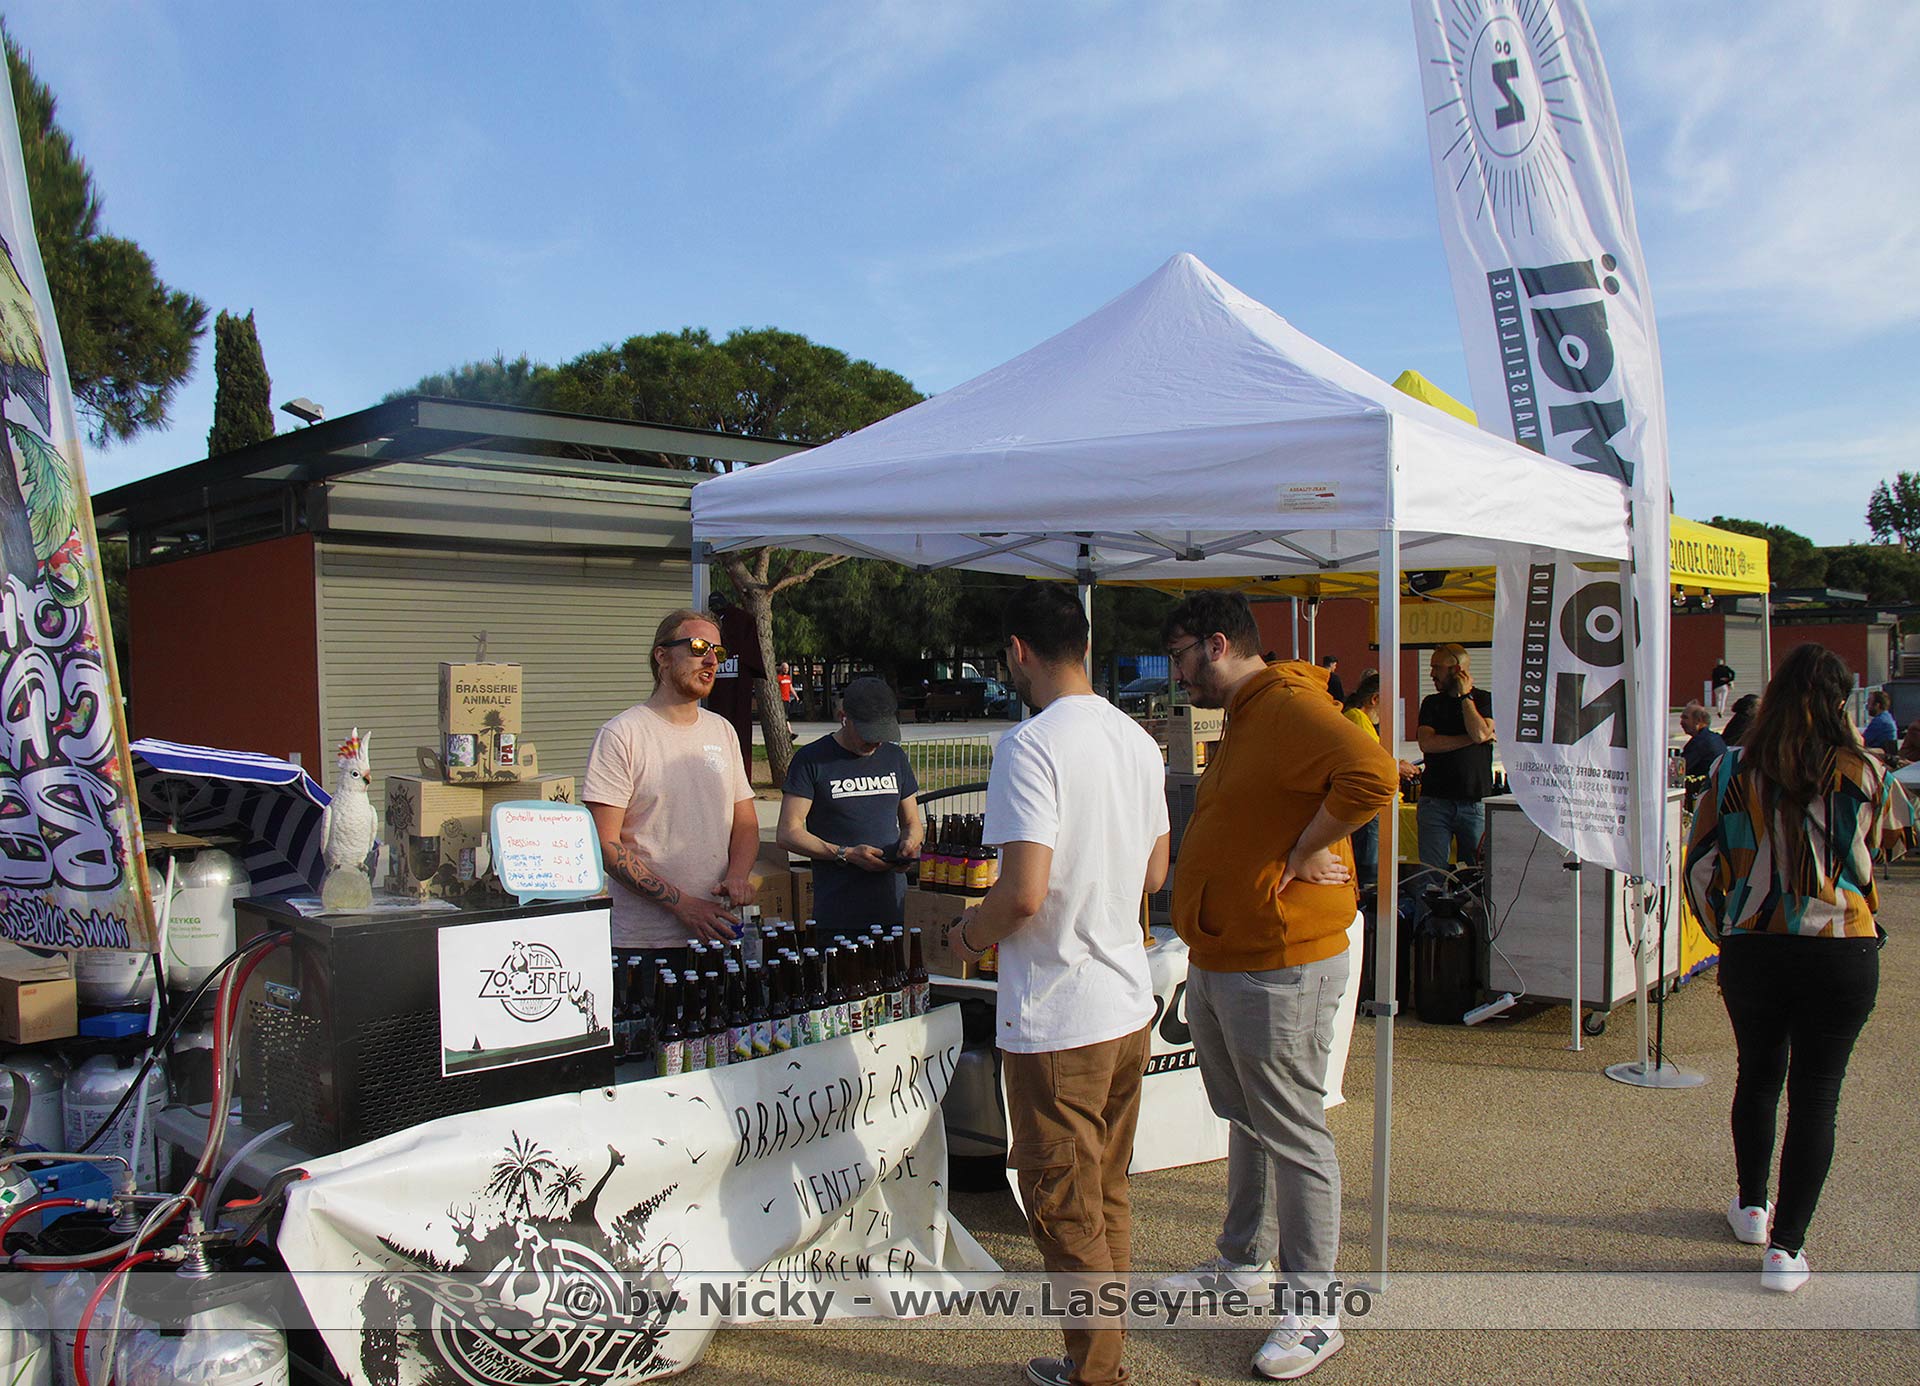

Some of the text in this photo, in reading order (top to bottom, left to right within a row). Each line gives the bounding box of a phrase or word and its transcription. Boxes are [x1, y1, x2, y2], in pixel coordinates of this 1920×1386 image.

[455, 684, 518, 694] BRASSERIE
[462, 695, 512, 705] ANIMALE
[735, 1071, 877, 1167] BRASSERIE
[466, 1350, 523, 1383] ANIMALE
[471, 1337, 536, 1378] BRASSERIE
